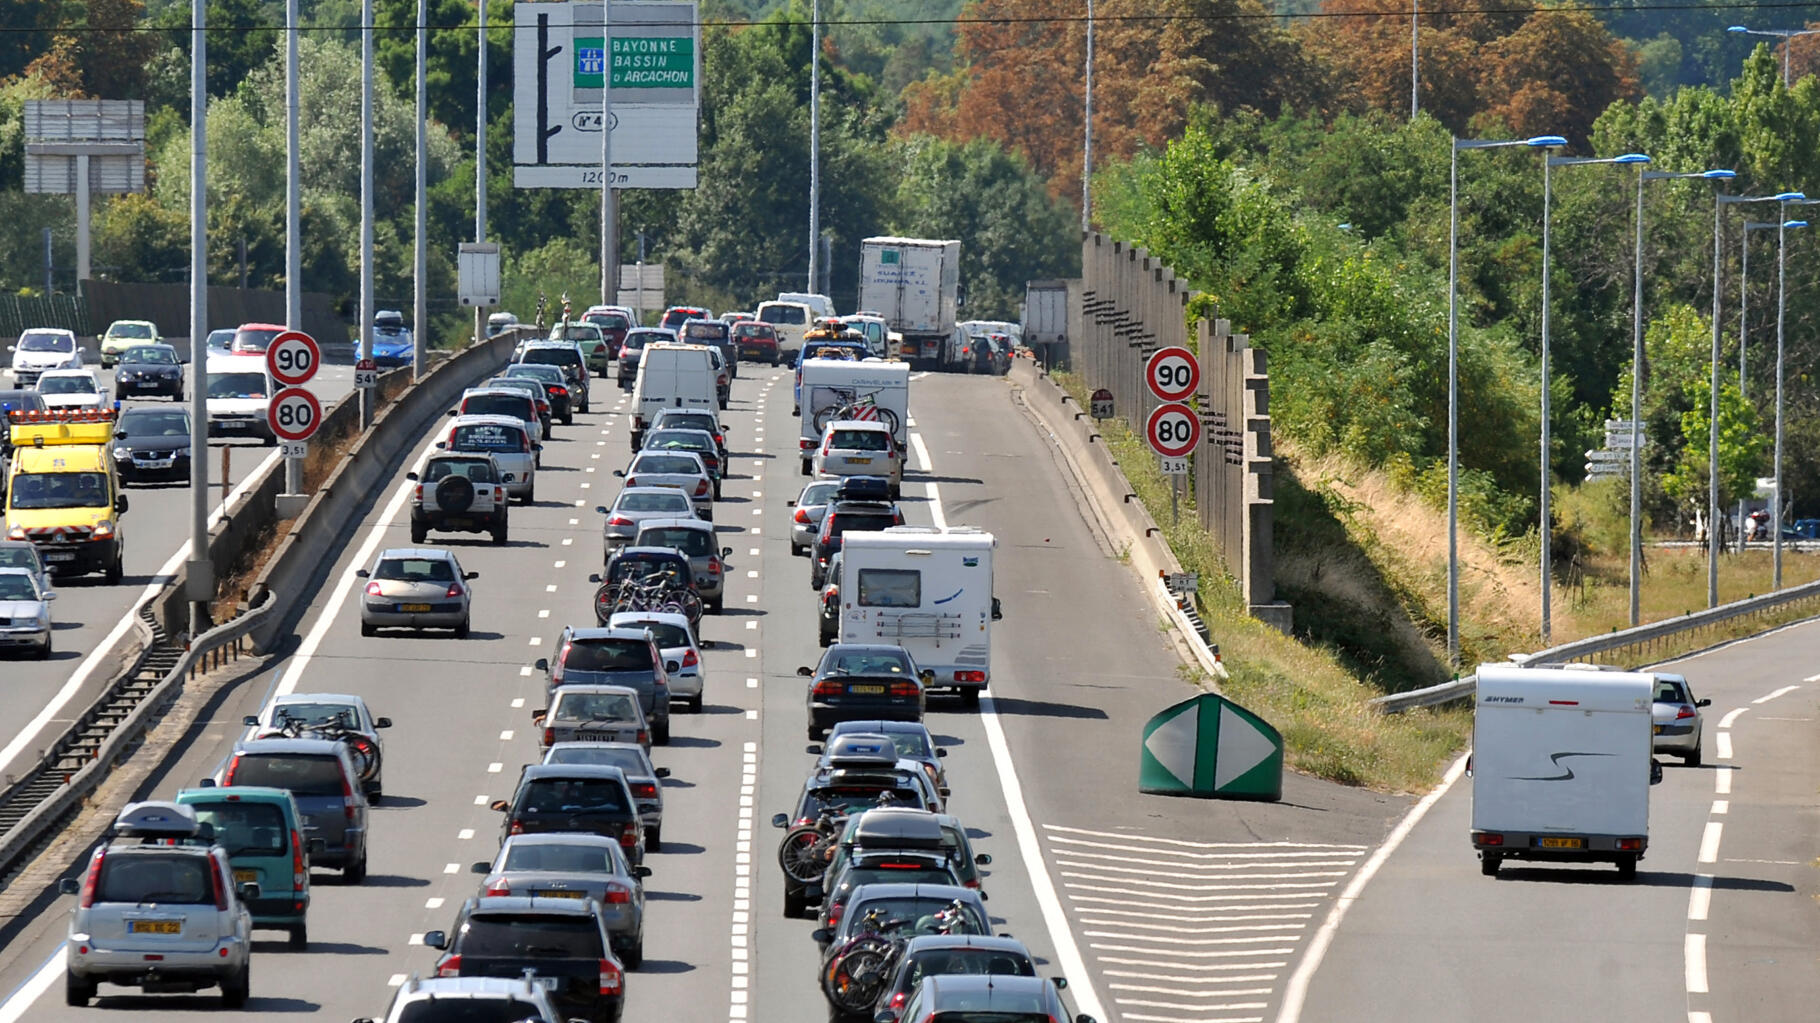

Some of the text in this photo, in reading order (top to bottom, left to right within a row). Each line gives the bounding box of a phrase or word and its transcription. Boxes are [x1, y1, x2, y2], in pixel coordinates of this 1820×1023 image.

[613, 40, 676, 52] BAYONNE
[614, 56, 667, 67] BASSIN
[278, 349, 310, 371] 90
[356, 374, 376, 384] 541
[1158, 365, 1191, 387] 90
[279, 404, 311, 426] 80
[1092, 404, 1113, 415] 541
[1158, 420, 1190, 442] 80
